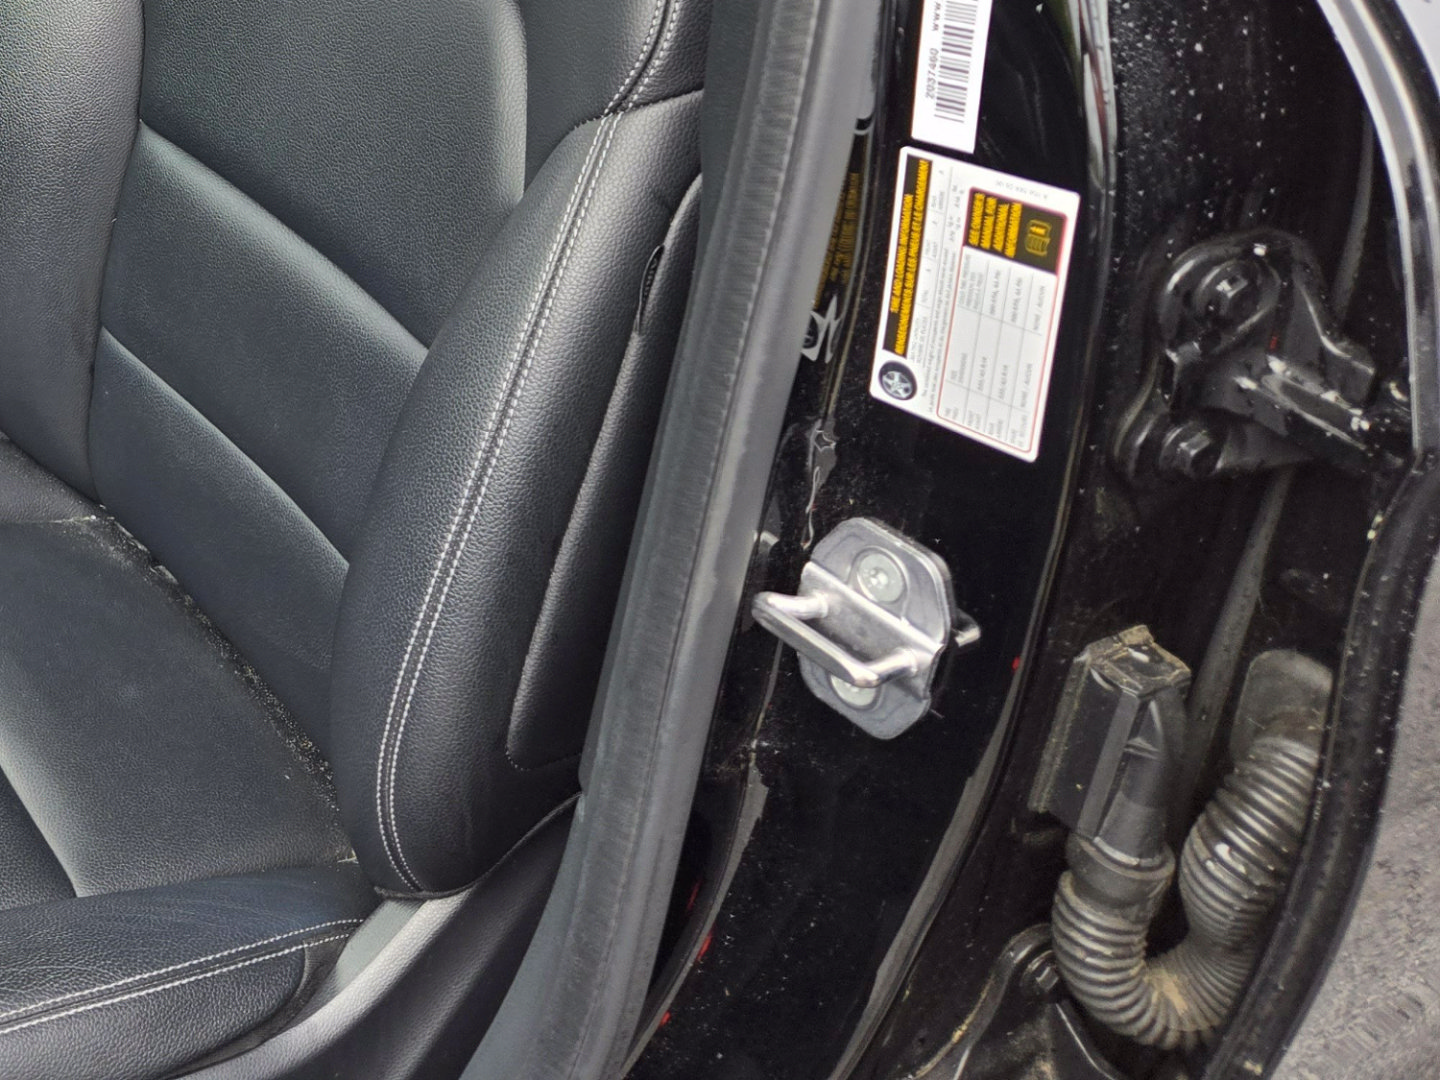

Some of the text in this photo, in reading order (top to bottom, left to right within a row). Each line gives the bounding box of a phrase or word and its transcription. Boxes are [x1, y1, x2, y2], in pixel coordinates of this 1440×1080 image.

[926, 48, 939, 99] 2037460
[900, 193, 912, 245] INFORMATION
[980, 214, 994, 249] MANUAL
[993, 202, 1008, 251] ADDITIONAL
[1005, 201, 1021, 257] INFORMATION
[895, 245, 906, 278] LOADING
[903, 271, 914, 288] SUR
[891, 278, 902, 295] AND
